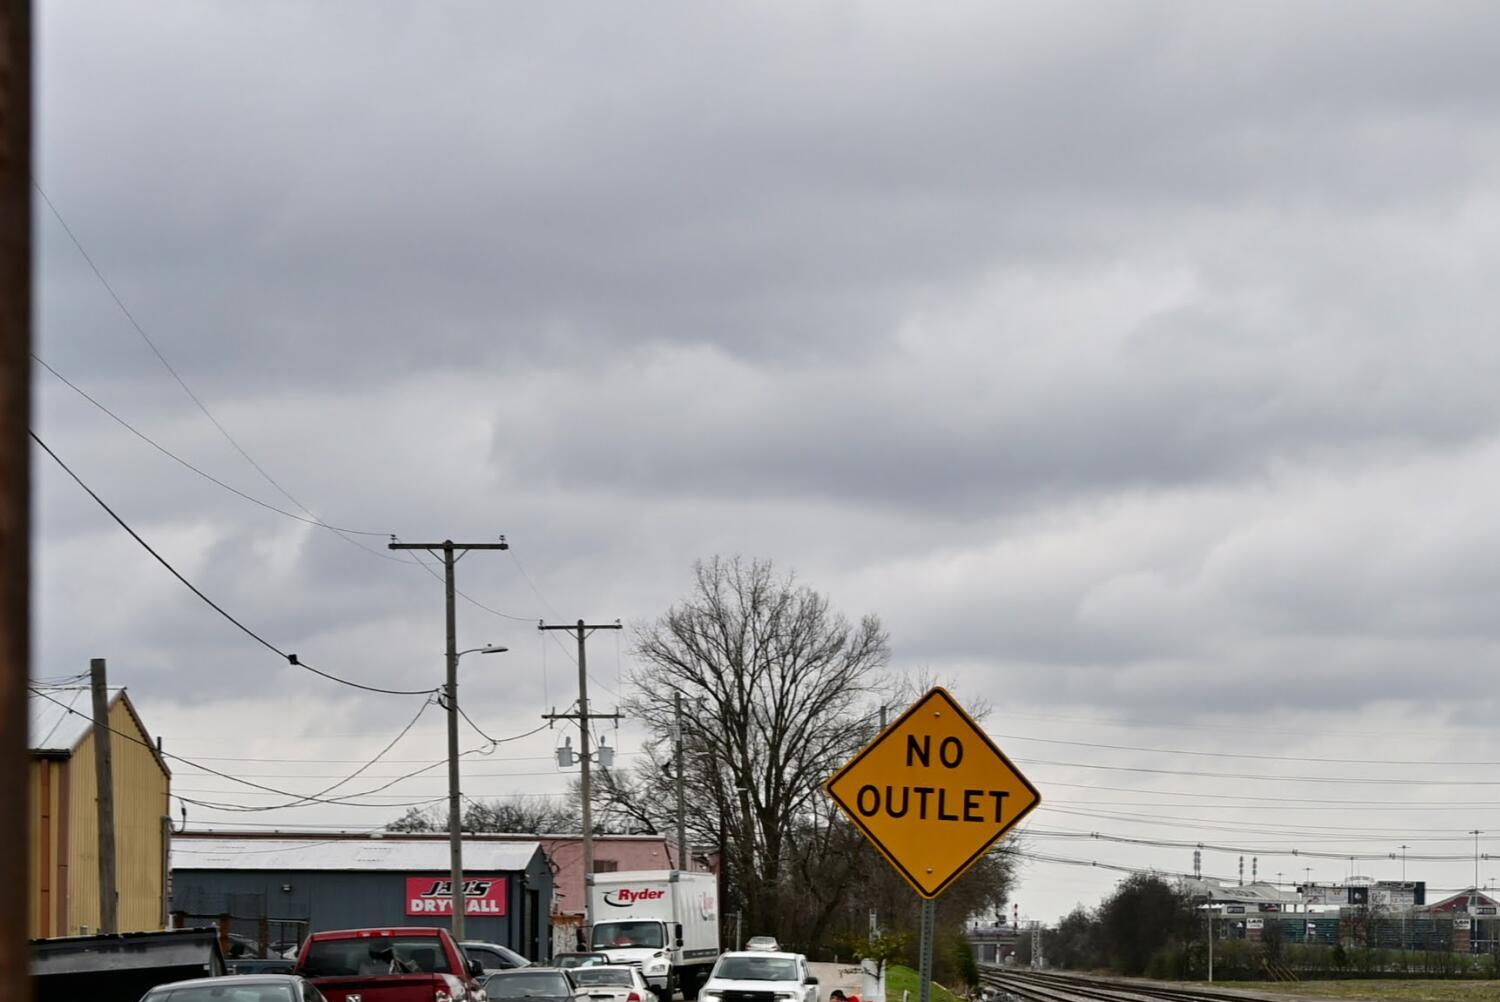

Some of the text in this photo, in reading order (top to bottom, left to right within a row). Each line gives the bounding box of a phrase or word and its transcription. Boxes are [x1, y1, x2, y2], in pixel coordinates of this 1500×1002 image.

[906, 734, 964, 769] NO
[856, 784, 1010, 824] OUTLET
[411, 899, 500, 913] DRYALL
[618, 888, 666, 903] Ryder
